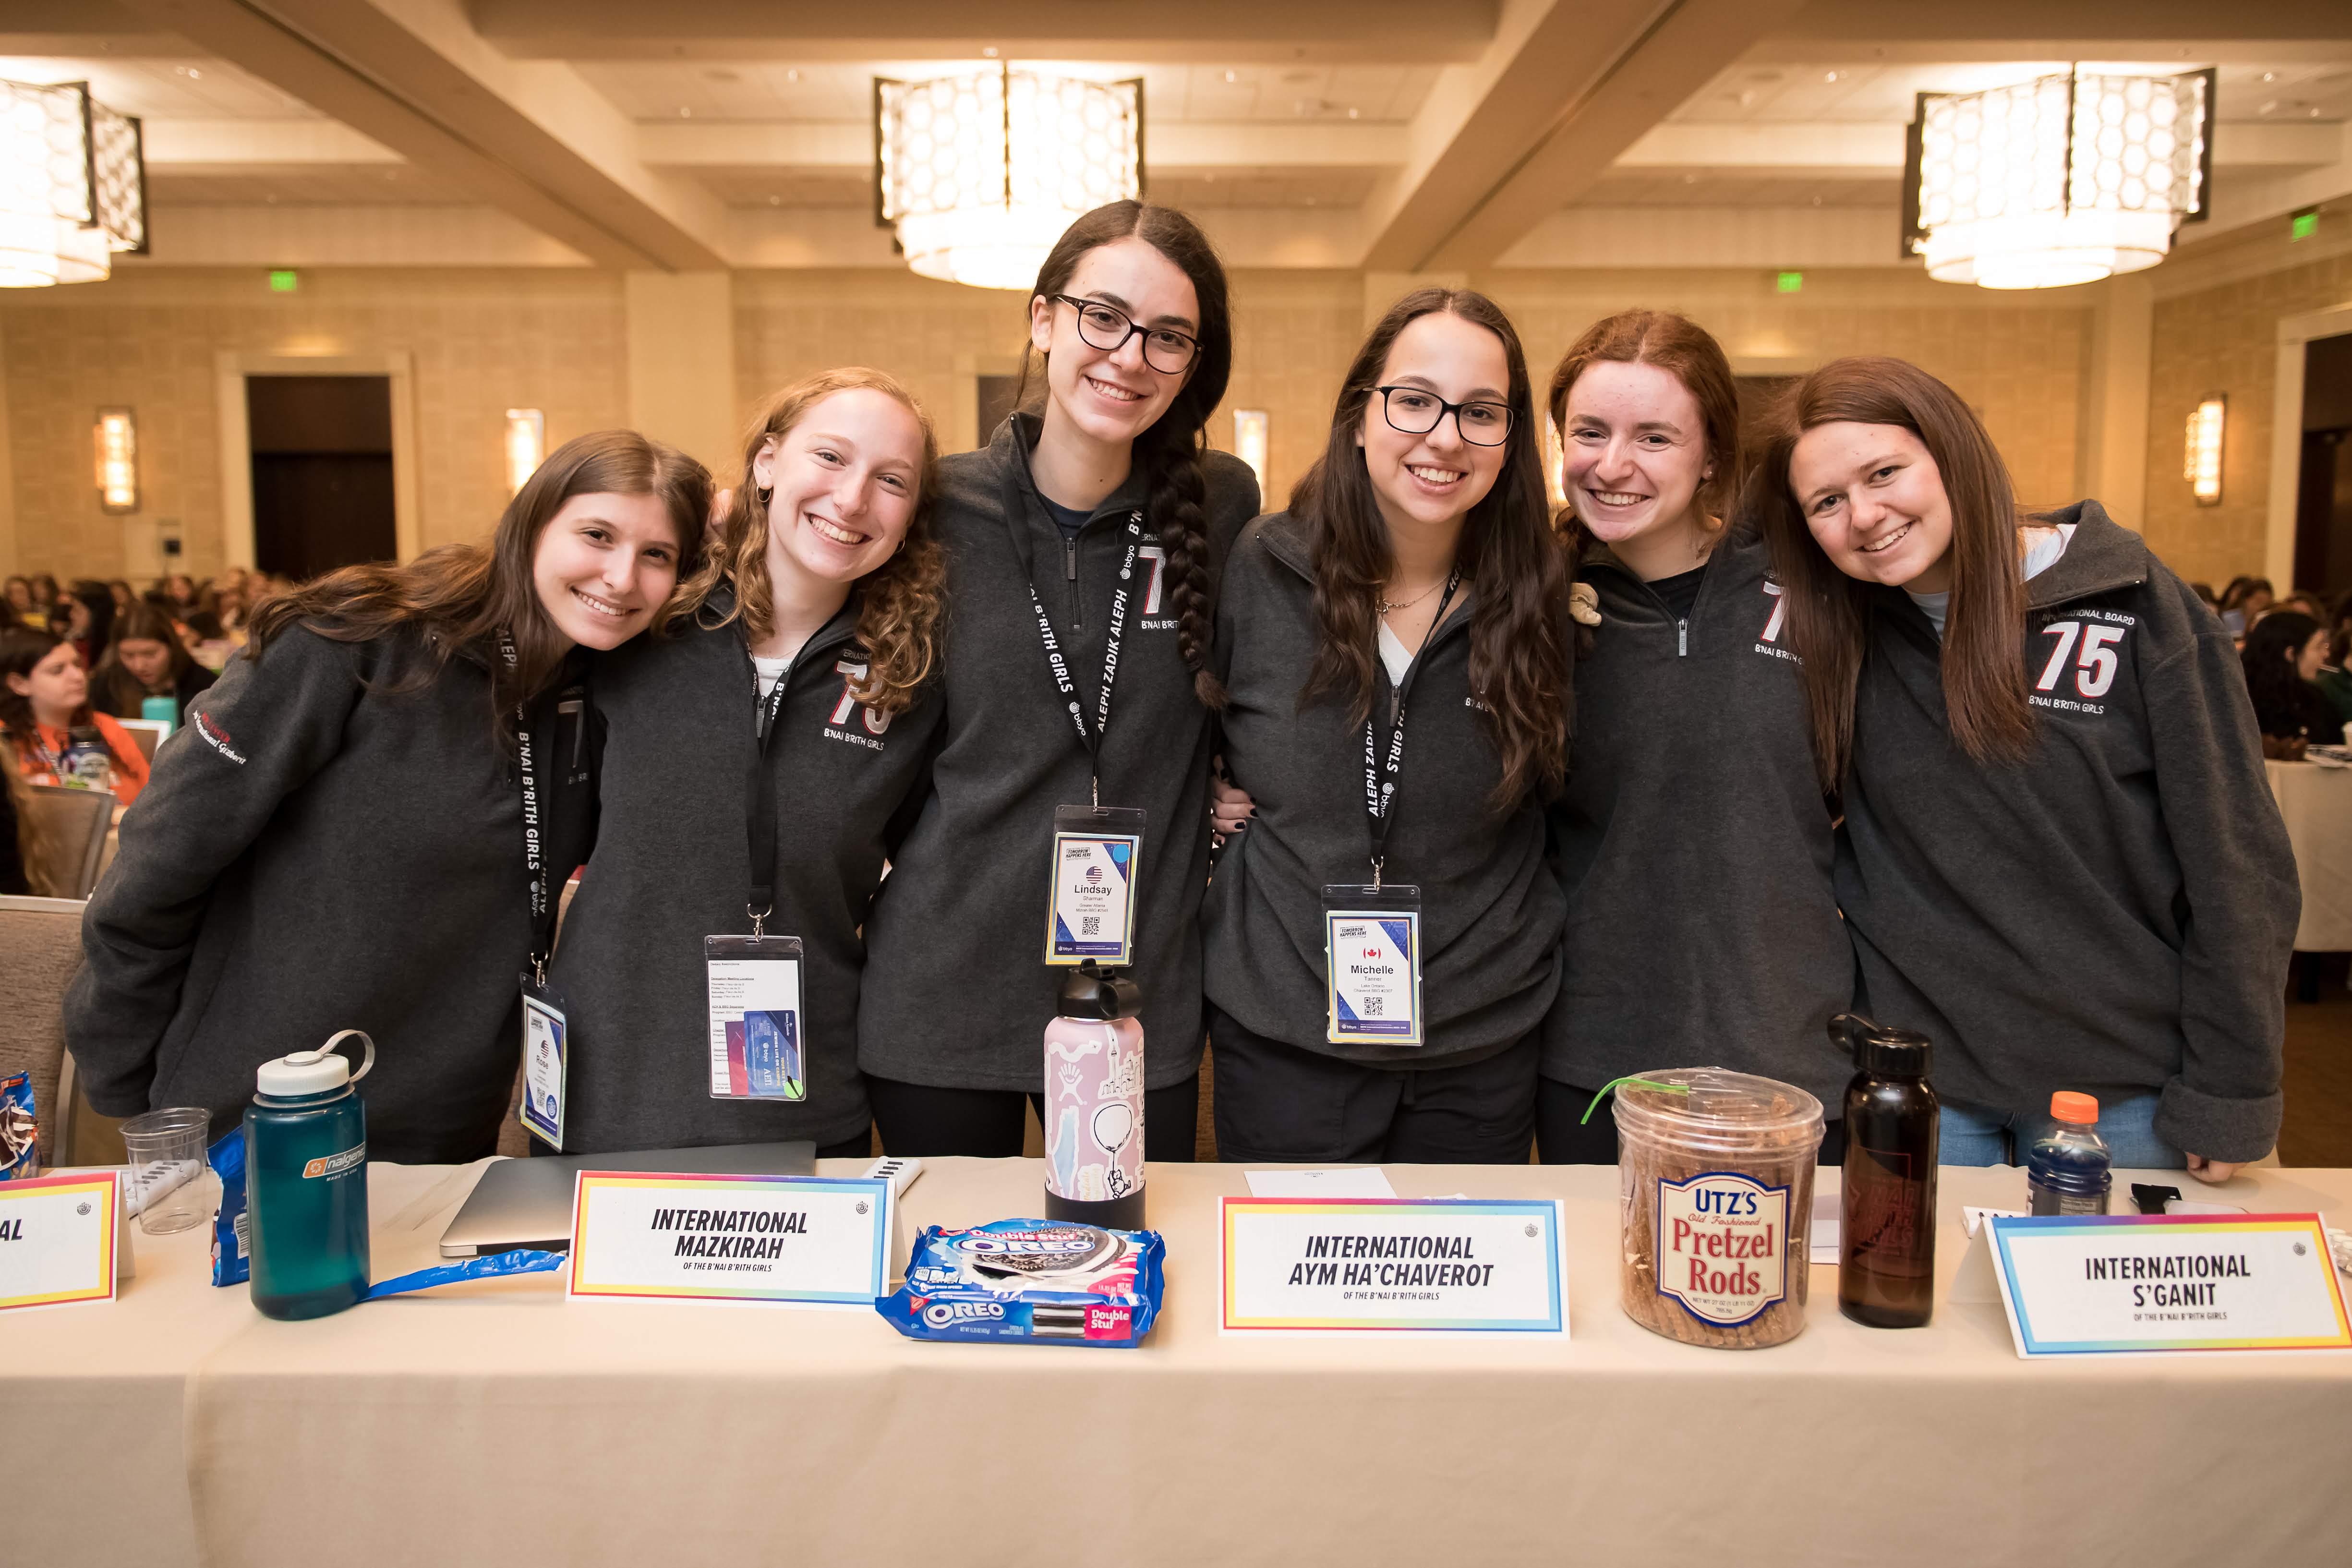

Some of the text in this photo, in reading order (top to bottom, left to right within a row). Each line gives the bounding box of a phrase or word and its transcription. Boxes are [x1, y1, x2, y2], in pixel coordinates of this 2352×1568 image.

[1123, 545, 1135, 568] bbyo
[1141, 620, 1180, 629] B'NAI B'RIT
[2105, 612, 2135, 625] BOARD
[1035, 604, 1073, 692] B'RITH GIRLS
[1755, 643, 1774, 656] B'NAI
[1098, 589, 1127, 733] ALEPH ZADIK ALEPH
[2036, 622, 2125, 698] 75
[2029, 696, 2104, 714] B'NAI B'RITH GIRLS
[1074, 713, 1086, 736] bbyo
[824, 728, 884, 750] B'NAI B'RITH GIRLS
[1387, 730, 1403, 773] GIRLS
[1366, 721, 1379, 817] ALEPH ZADIK
[519, 732, 540, 870] B'NAI B'RITH GIRLS
[1074, 885, 1112, 896] Lindsay
[1351, 965, 1394, 974] Michelle
[1696, 1188, 1757, 1215] UTZ'S
[651, 1209, 807, 1233] INTERNATIONAL
[1688, 1213, 1761, 1226] Old Fashioned
[674, 1235, 784, 1259] MAZKIRAH
[959, 1239, 1095, 1253] OREO
[969, 1230, 1036, 1241] Double
[1038, 1232, 1076, 1241] Stuf
[1305, 1236, 1474, 1258] INTERNATIONAL
[1673, 1218, 1773, 1259] Pretzel
[728, 1263, 752, 1271] B'RITH
[1289, 1263, 1494, 1286] AYM HA'CHAVEROT
[1689, 1257, 1761, 1296] Rods
[2086, 1255, 2250, 1280] INTERNATIONAL
[2133, 1283, 2216, 1306] S'GANIT
[925, 1302, 1006, 1324] OREO
[1091, 1309, 1129, 1320] Double
[1091, 1320, 1114, 1329] Stuf
